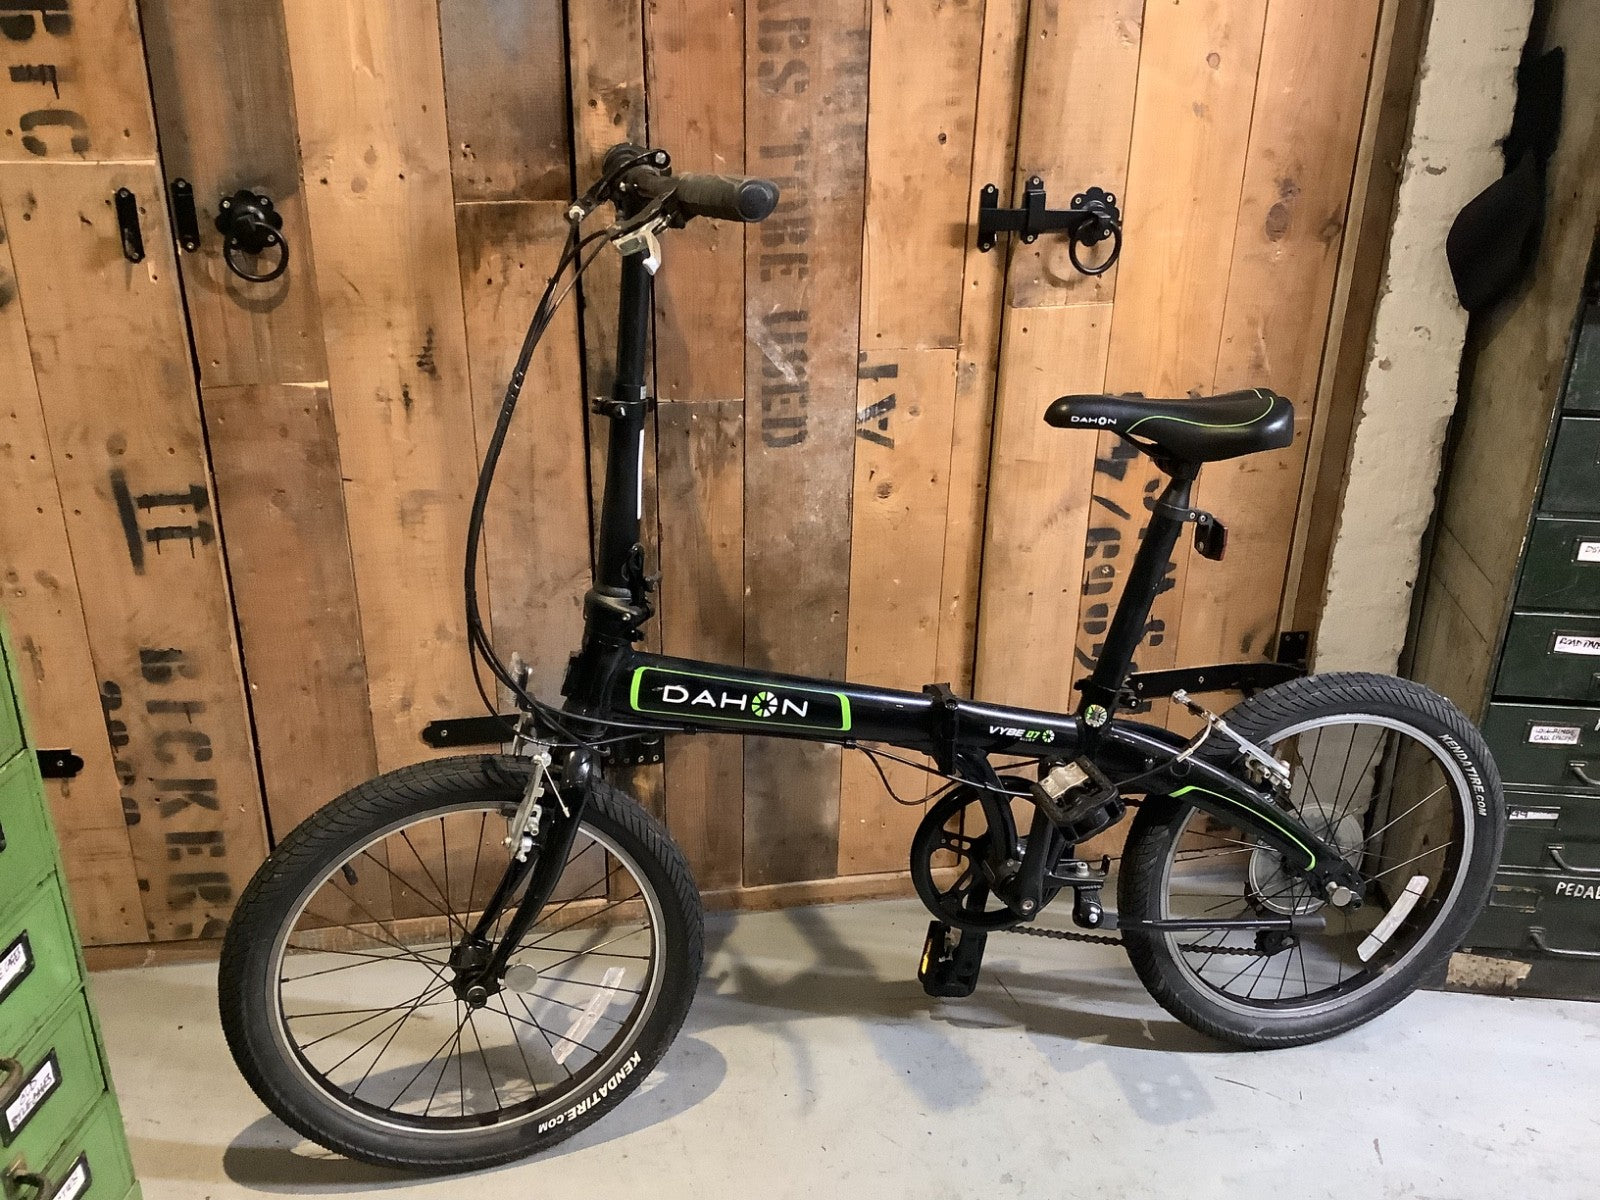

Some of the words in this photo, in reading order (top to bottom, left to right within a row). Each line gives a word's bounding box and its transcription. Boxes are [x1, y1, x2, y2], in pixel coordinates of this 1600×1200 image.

[760, 310, 810, 448] USED
[1070, 415, 1118, 426] DAHON
[662, 684, 809, 718] DAHON
[989, 725, 1025, 737] VYBE
[1025, 730, 1041, 739] 07
[1438, 733, 1488, 817] KENDATIRE.COM
[538, 1050, 642, 1134] KENDATIRE.COM
